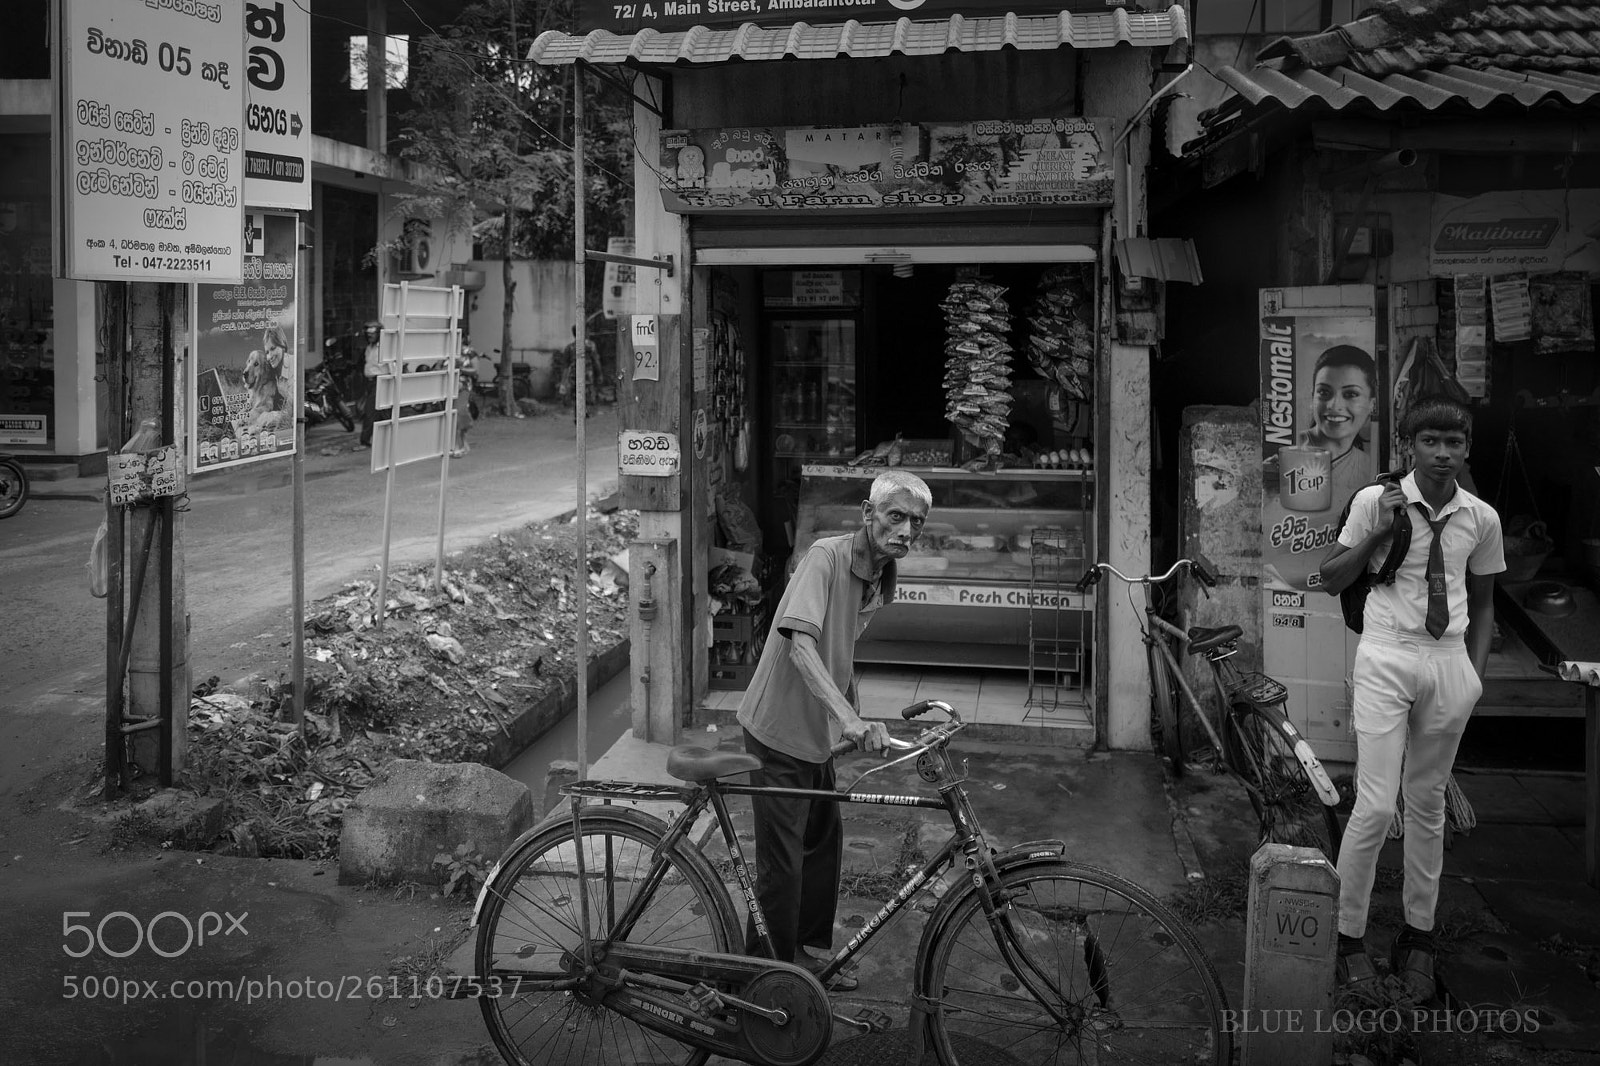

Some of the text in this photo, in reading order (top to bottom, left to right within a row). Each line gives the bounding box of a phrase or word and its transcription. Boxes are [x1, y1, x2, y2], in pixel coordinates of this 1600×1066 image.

[613, 4, 637, 19] 72/
[642, 3, 658, 20] A,
[664, 0, 701, 16] Main
[707, 0, 761, 17] Street,
[86, 27, 149, 66] විනාඩි
[158, 42, 192, 76] 05
[77, 99, 111, 129] ටයිප්
[114, 108, 155, 137] සෙටින්
[1037, 151, 1075, 161] MEAT
[954, 158, 992, 173] රසය
[1031, 161, 1076, 171] CURRY
[1018, 171, 1075, 182] POWDER
[1015, 181, 1076, 190] MIXTURE
[782, 194, 873, 206] Farm
[882, 191, 966, 206] shop
[978, 193, 1088, 204] Ambalantota
[1444, 223, 1543, 241] Maliban
[86, 238, 106, 250] අංක
[109, 239, 118, 250] 4,
[120, 239, 156, 253] ධර්මපාල
[113, 254, 132, 268] Tel
[142, 256, 211, 271] 047-2223511
[1265, 323, 1293, 446] Nestomalt
[1298, 475, 1324, 492] Cup
[1271, 515, 1308, 547] දවස
[959, 590, 1002, 605] Fresh
[1007, 591, 1070, 607] Chicken
[849, 793, 920, 806] EXPORT QUALITY
[735, 864, 768, 937] SINGER
[848, 898, 900, 950] SINGER
[1276, 912, 1319, 938] WO
[641, 1000, 685, 1026] SINGER
